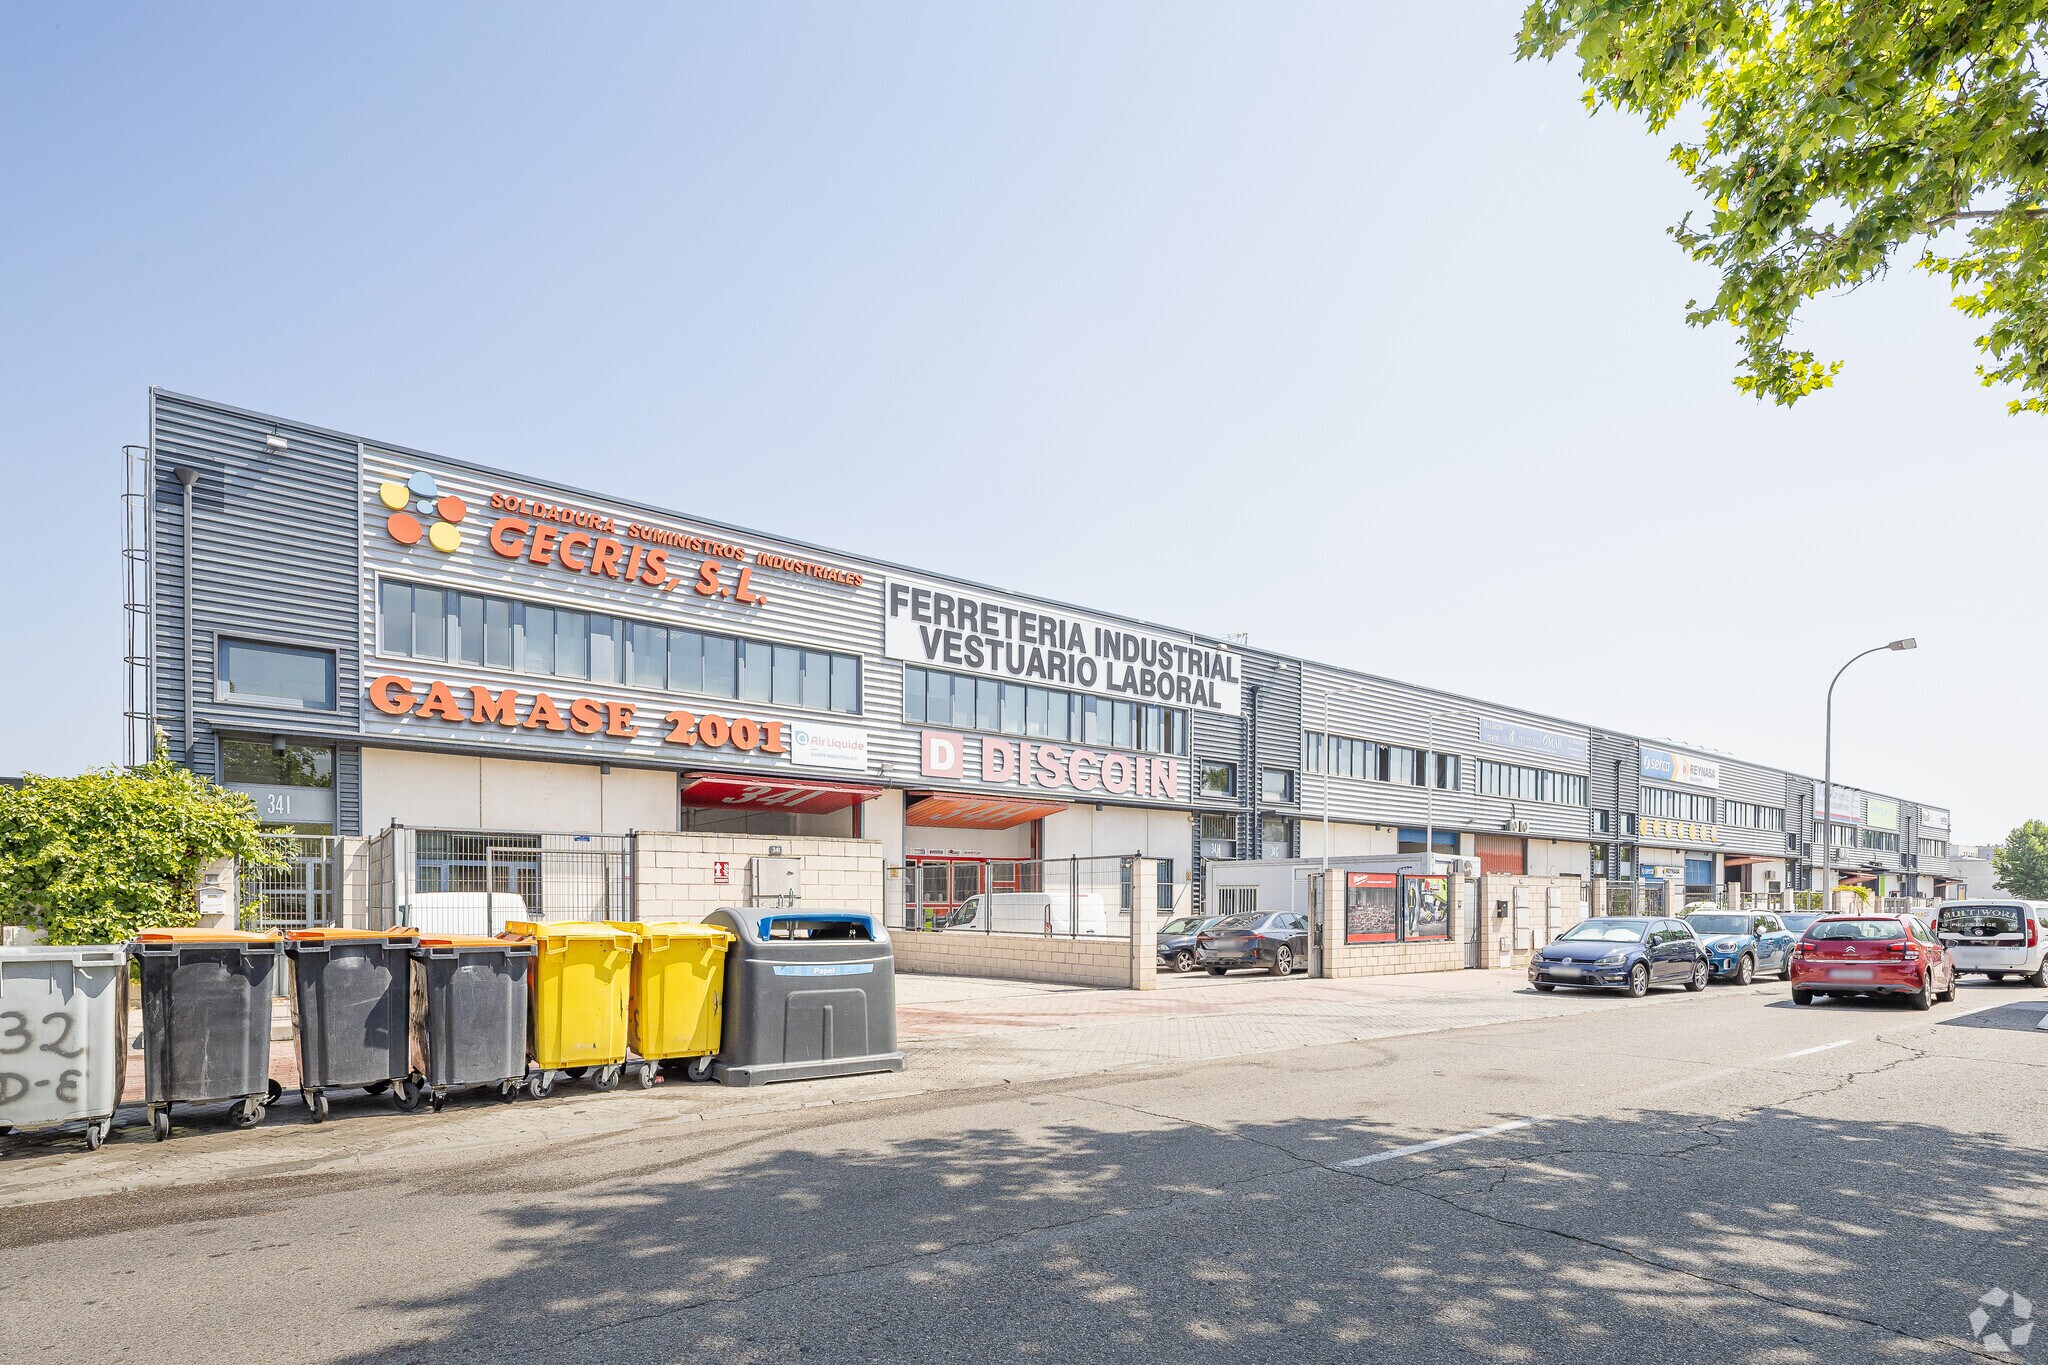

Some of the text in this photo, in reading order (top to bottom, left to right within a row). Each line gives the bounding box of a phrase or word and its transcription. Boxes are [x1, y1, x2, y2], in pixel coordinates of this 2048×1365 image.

[490, 518, 768, 605] GECRIS, S.L.
[491, 493, 864, 587] SOLDADURA SUMINISTROS INDUSTRIALES
[890, 583, 1239, 684] FERRETERIA INDUSTRIAL
[919, 625, 1221, 709] VESTUARIO LABORAL
[369, 675, 788, 753] GAMASE 2001
[981, 737, 1178, 798] DISCOIN
[1651, 758, 1670, 772] serca
[1690, 764, 1715, 779] REYNASA
[813, 967, 835, 975] Papel
[0, 1011, 85, 1059] 32
